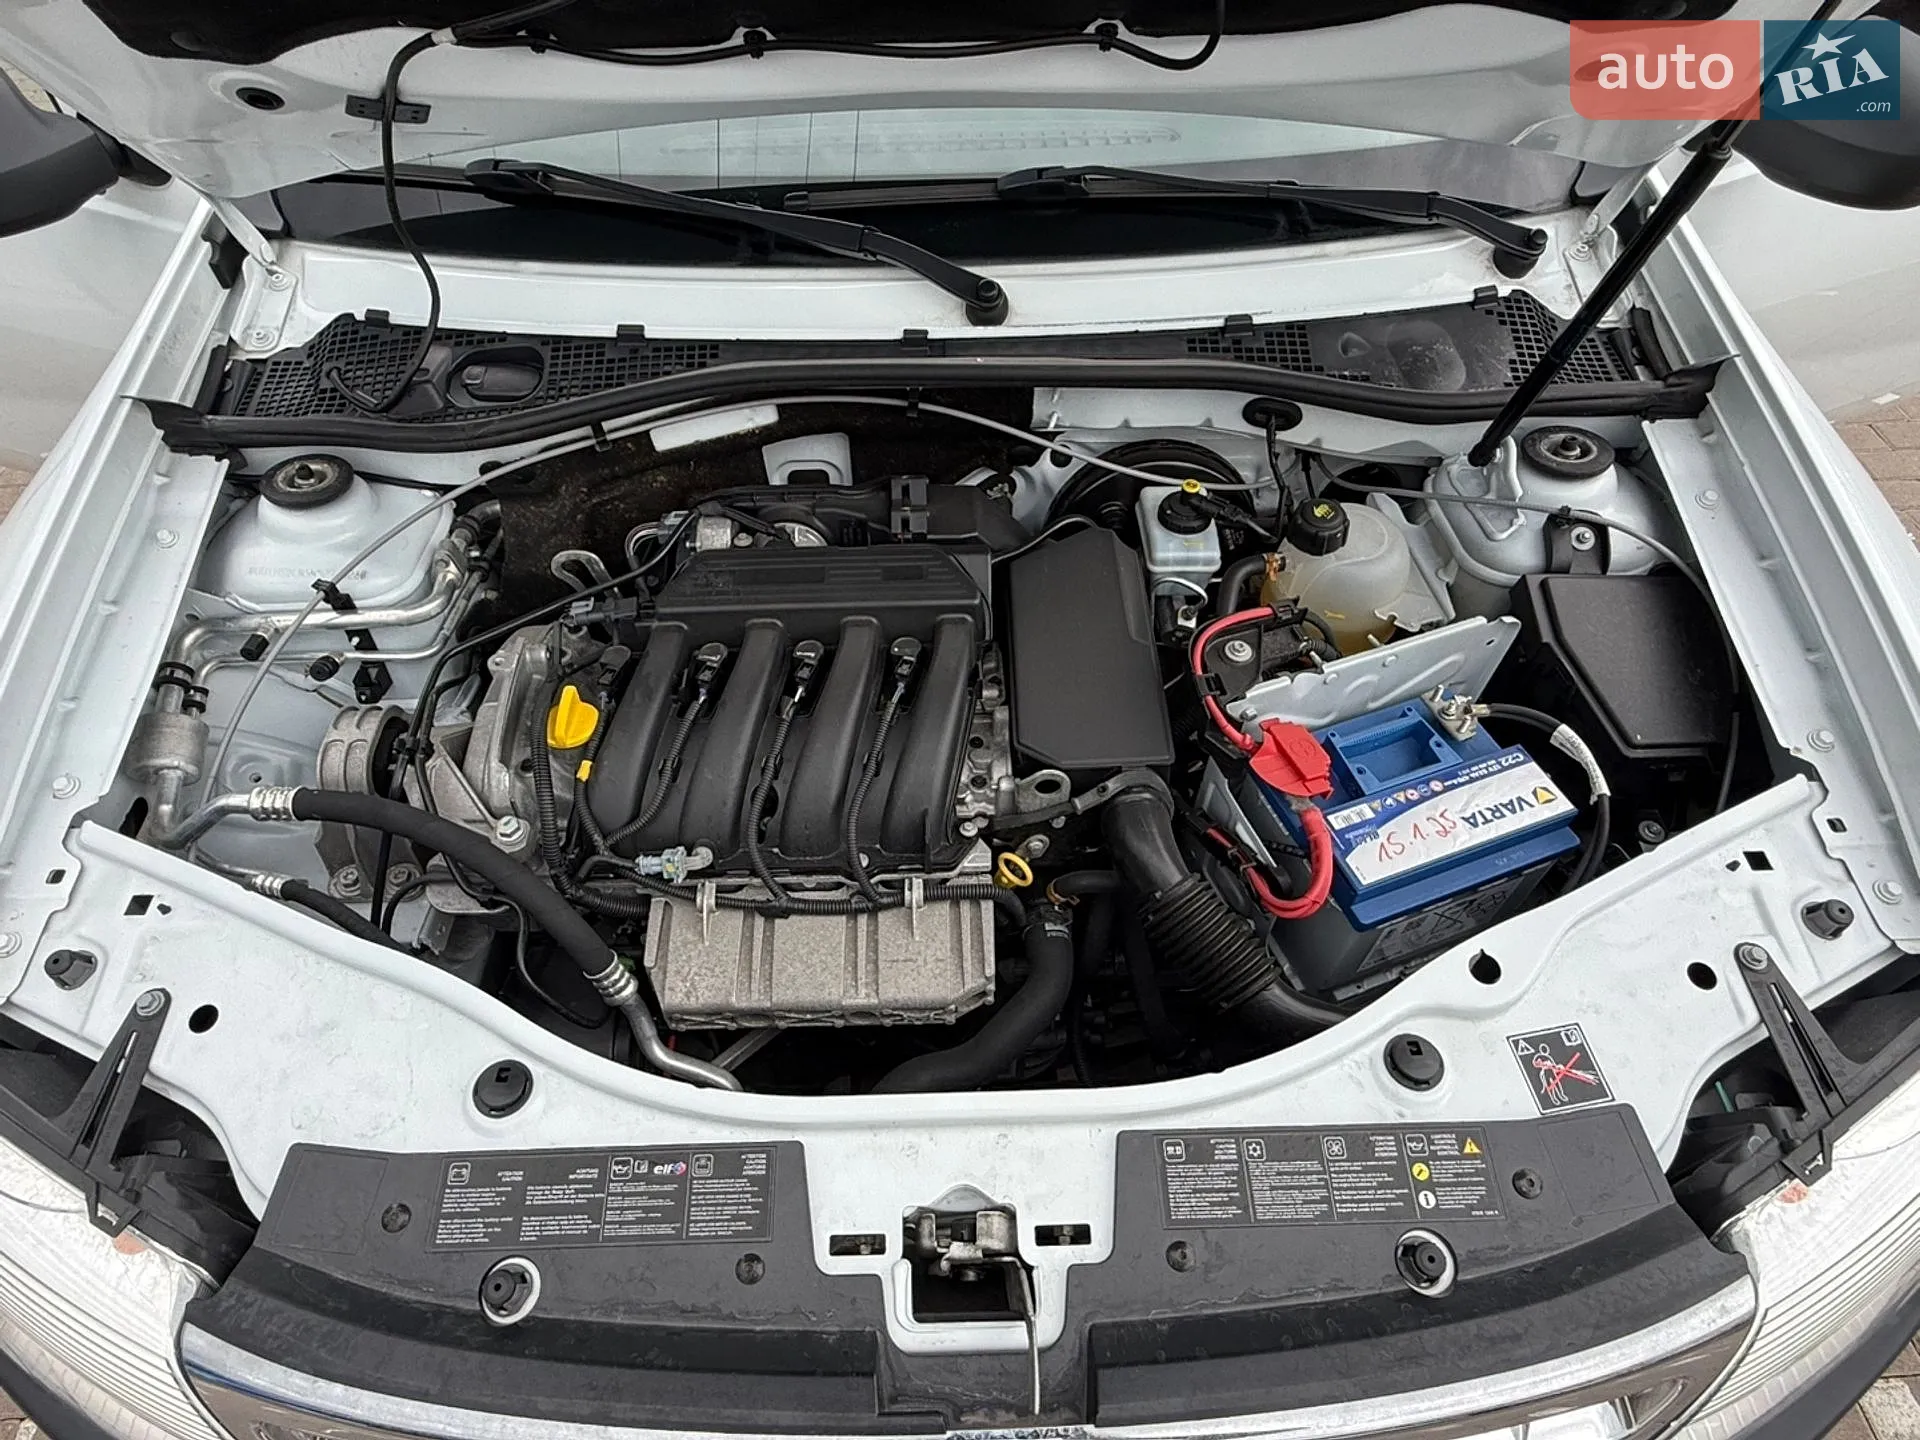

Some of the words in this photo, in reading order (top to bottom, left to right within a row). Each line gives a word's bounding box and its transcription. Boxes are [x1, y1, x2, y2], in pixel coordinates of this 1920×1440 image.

[1498, 752, 1524, 767] C22
[1460, 794, 1535, 828] VARTA
[653, 1163, 675, 1176] elf
